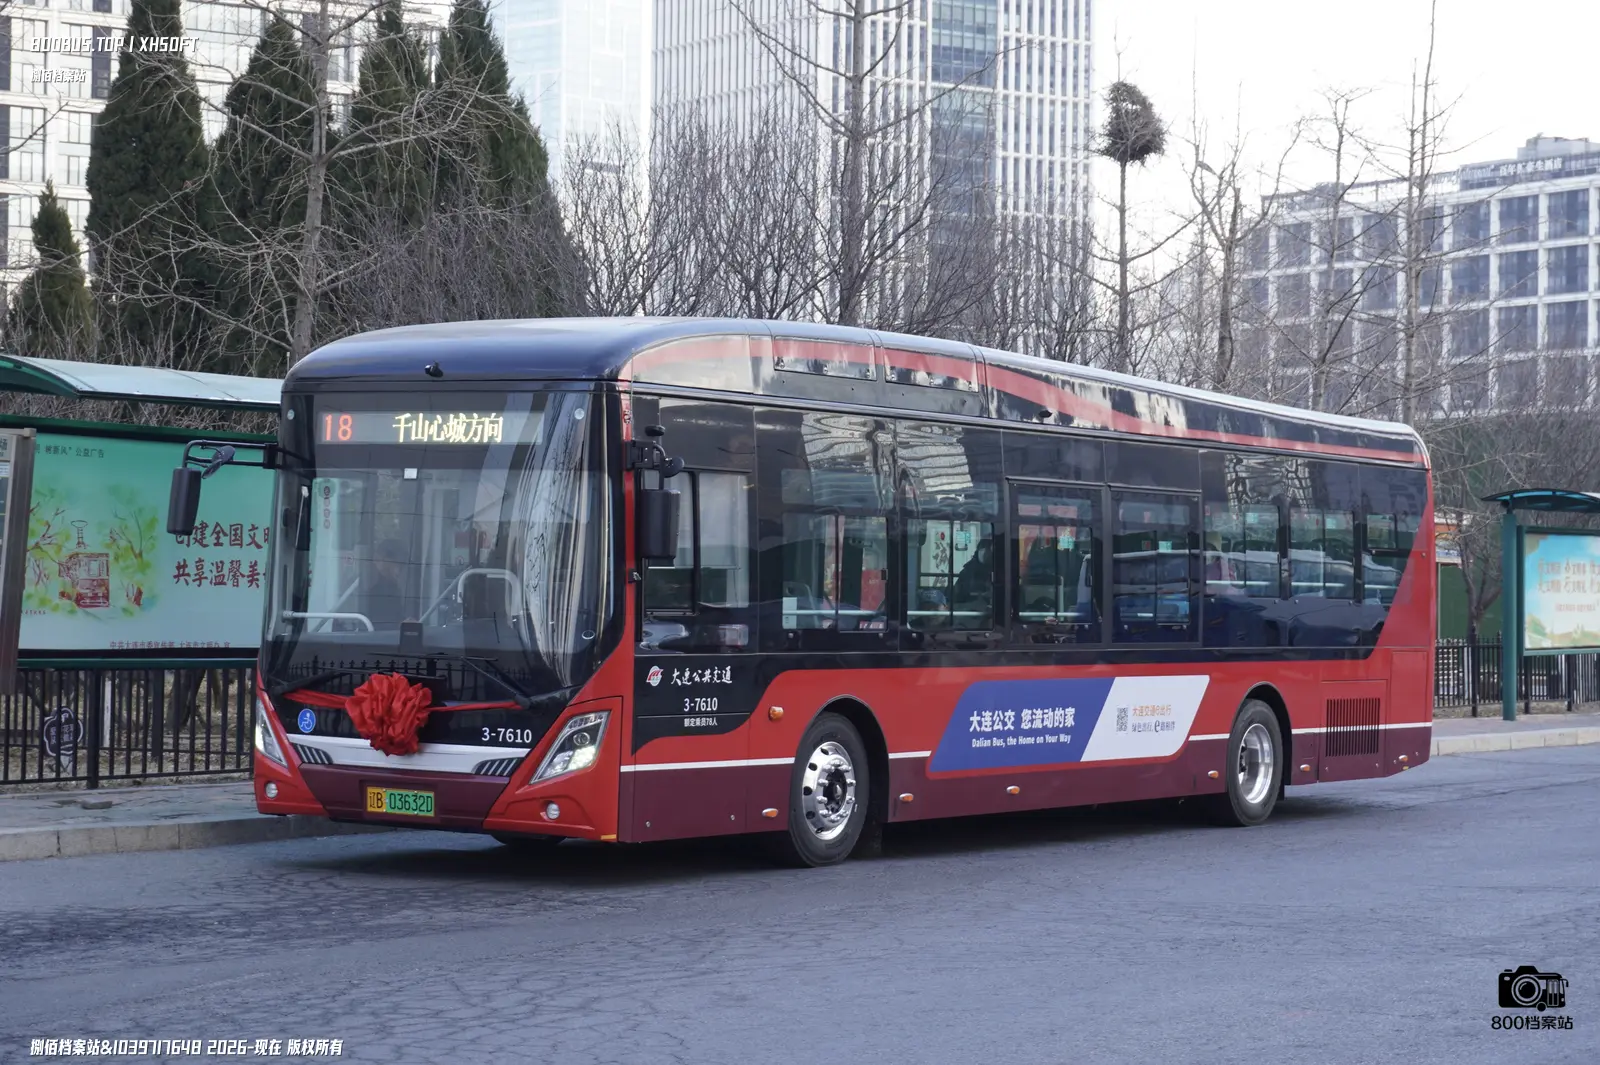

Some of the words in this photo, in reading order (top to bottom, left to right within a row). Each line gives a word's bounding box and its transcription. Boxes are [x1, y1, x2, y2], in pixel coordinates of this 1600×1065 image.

[324, 414, 353, 441] 18
[392, 412, 504, 443] 千山心城方向
[173, 557, 266, 588] 共享温馨美
[683, 697, 718, 712] 3-7610
[969, 709, 1016, 733] 大连公交
[1020, 706, 1076, 730] 您流动的家
[481, 727, 533, 744] 3-7610
[971, 737, 991, 748] Dalian
[992, 737, 1006, 748] Bus,
[1007, 736, 1017, 746] the
[1018, 735, 1035, 745] Home
[1036, 736, 1044, 744] on
[1045, 734, 1058, 743] Your
[1059, 733, 1072, 744] Way
